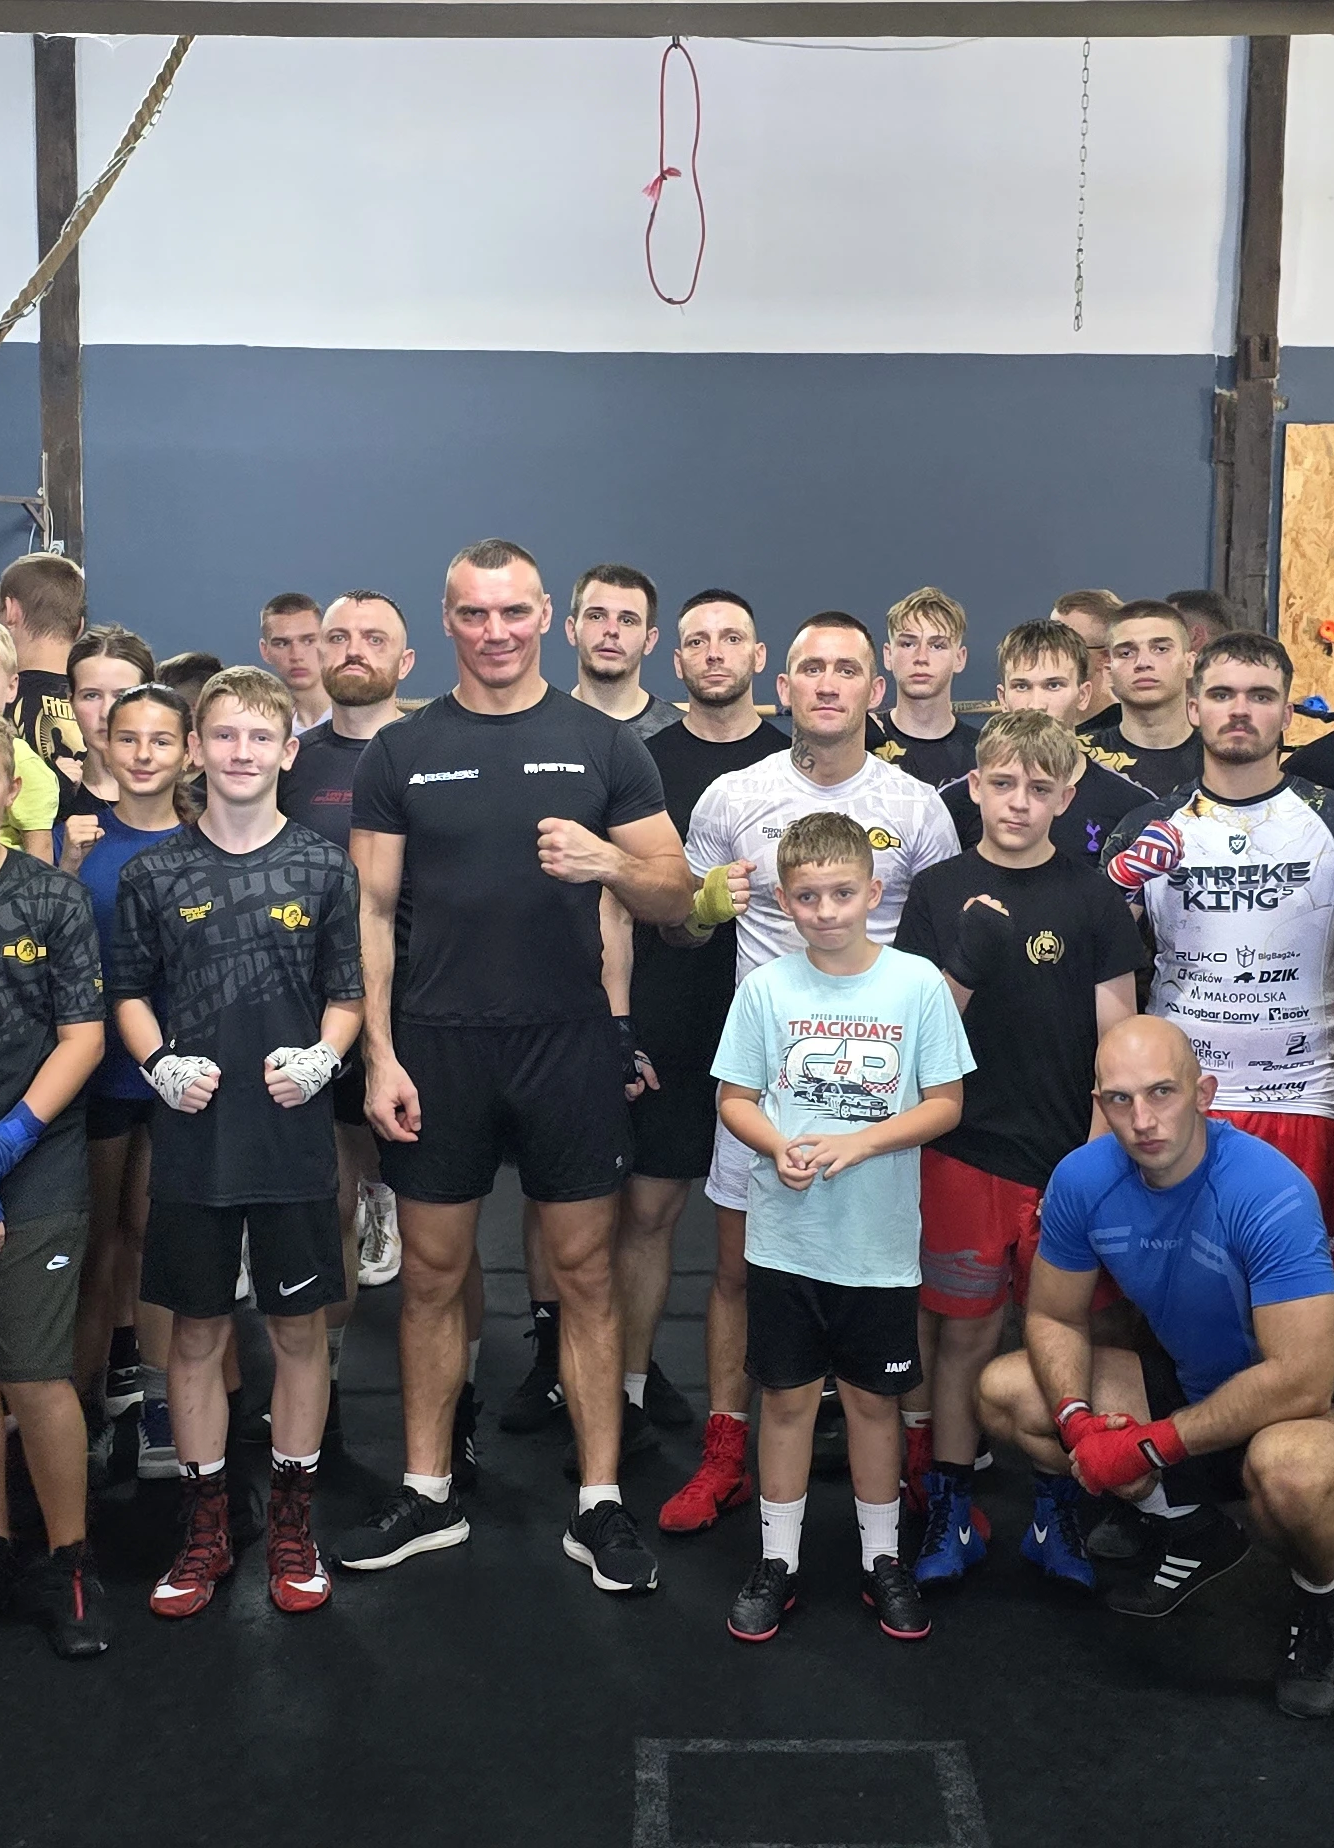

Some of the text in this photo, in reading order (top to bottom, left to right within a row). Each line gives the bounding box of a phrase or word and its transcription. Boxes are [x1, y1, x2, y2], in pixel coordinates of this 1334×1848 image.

[1167, 861, 1311, 888] STRIKE
[1175, 951, 1228, 963] RUKO
[1188, 970, 1223, 984] Kraków
[1203, 991, 1287, 1003] MAŁOPOLSKA
[1182, 1005, 1260, 1023] Logbar Domy
[1282, 1009, 1310, 1020] BODY
[788, 1020, 904, 1042] TRACKDAYS
